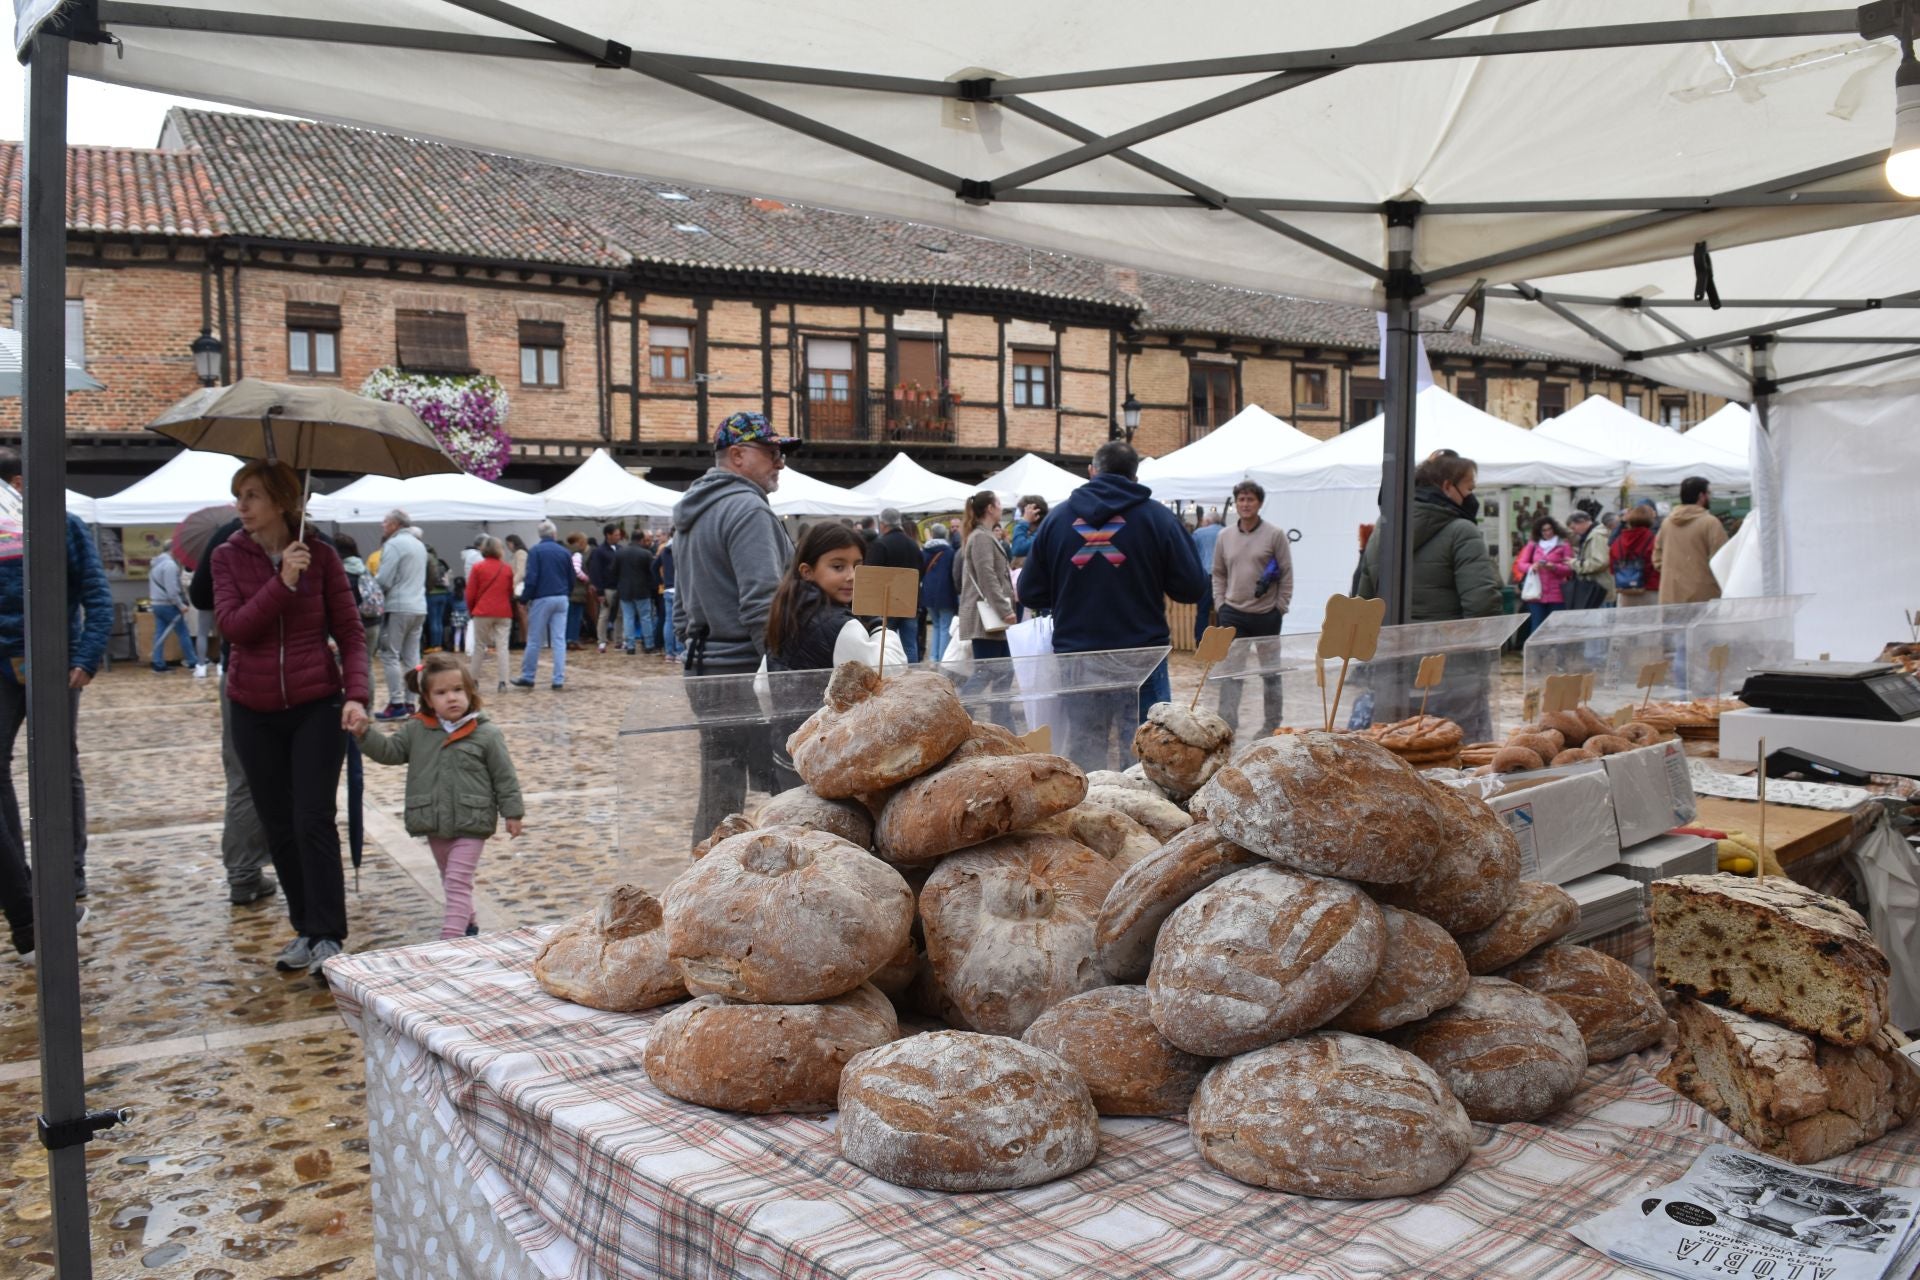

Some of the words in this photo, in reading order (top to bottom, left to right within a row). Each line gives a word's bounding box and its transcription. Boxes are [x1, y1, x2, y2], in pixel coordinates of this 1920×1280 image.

[1699, 1229, 1750, 1246] Saldaña
[1699, 1236, 1730, 1247] 2025
[1732, 1246, 1784, 1259] octubre
[1797, 1253, 1833, 1262] plaza
[1676, 1254, 1700, 1266] LA
[1677, 1237, 1836, 1280] ALUBIA
[1787, 1257, 1822, 1266] 18/19
[1713, 1265, 1739, 1275] DE
